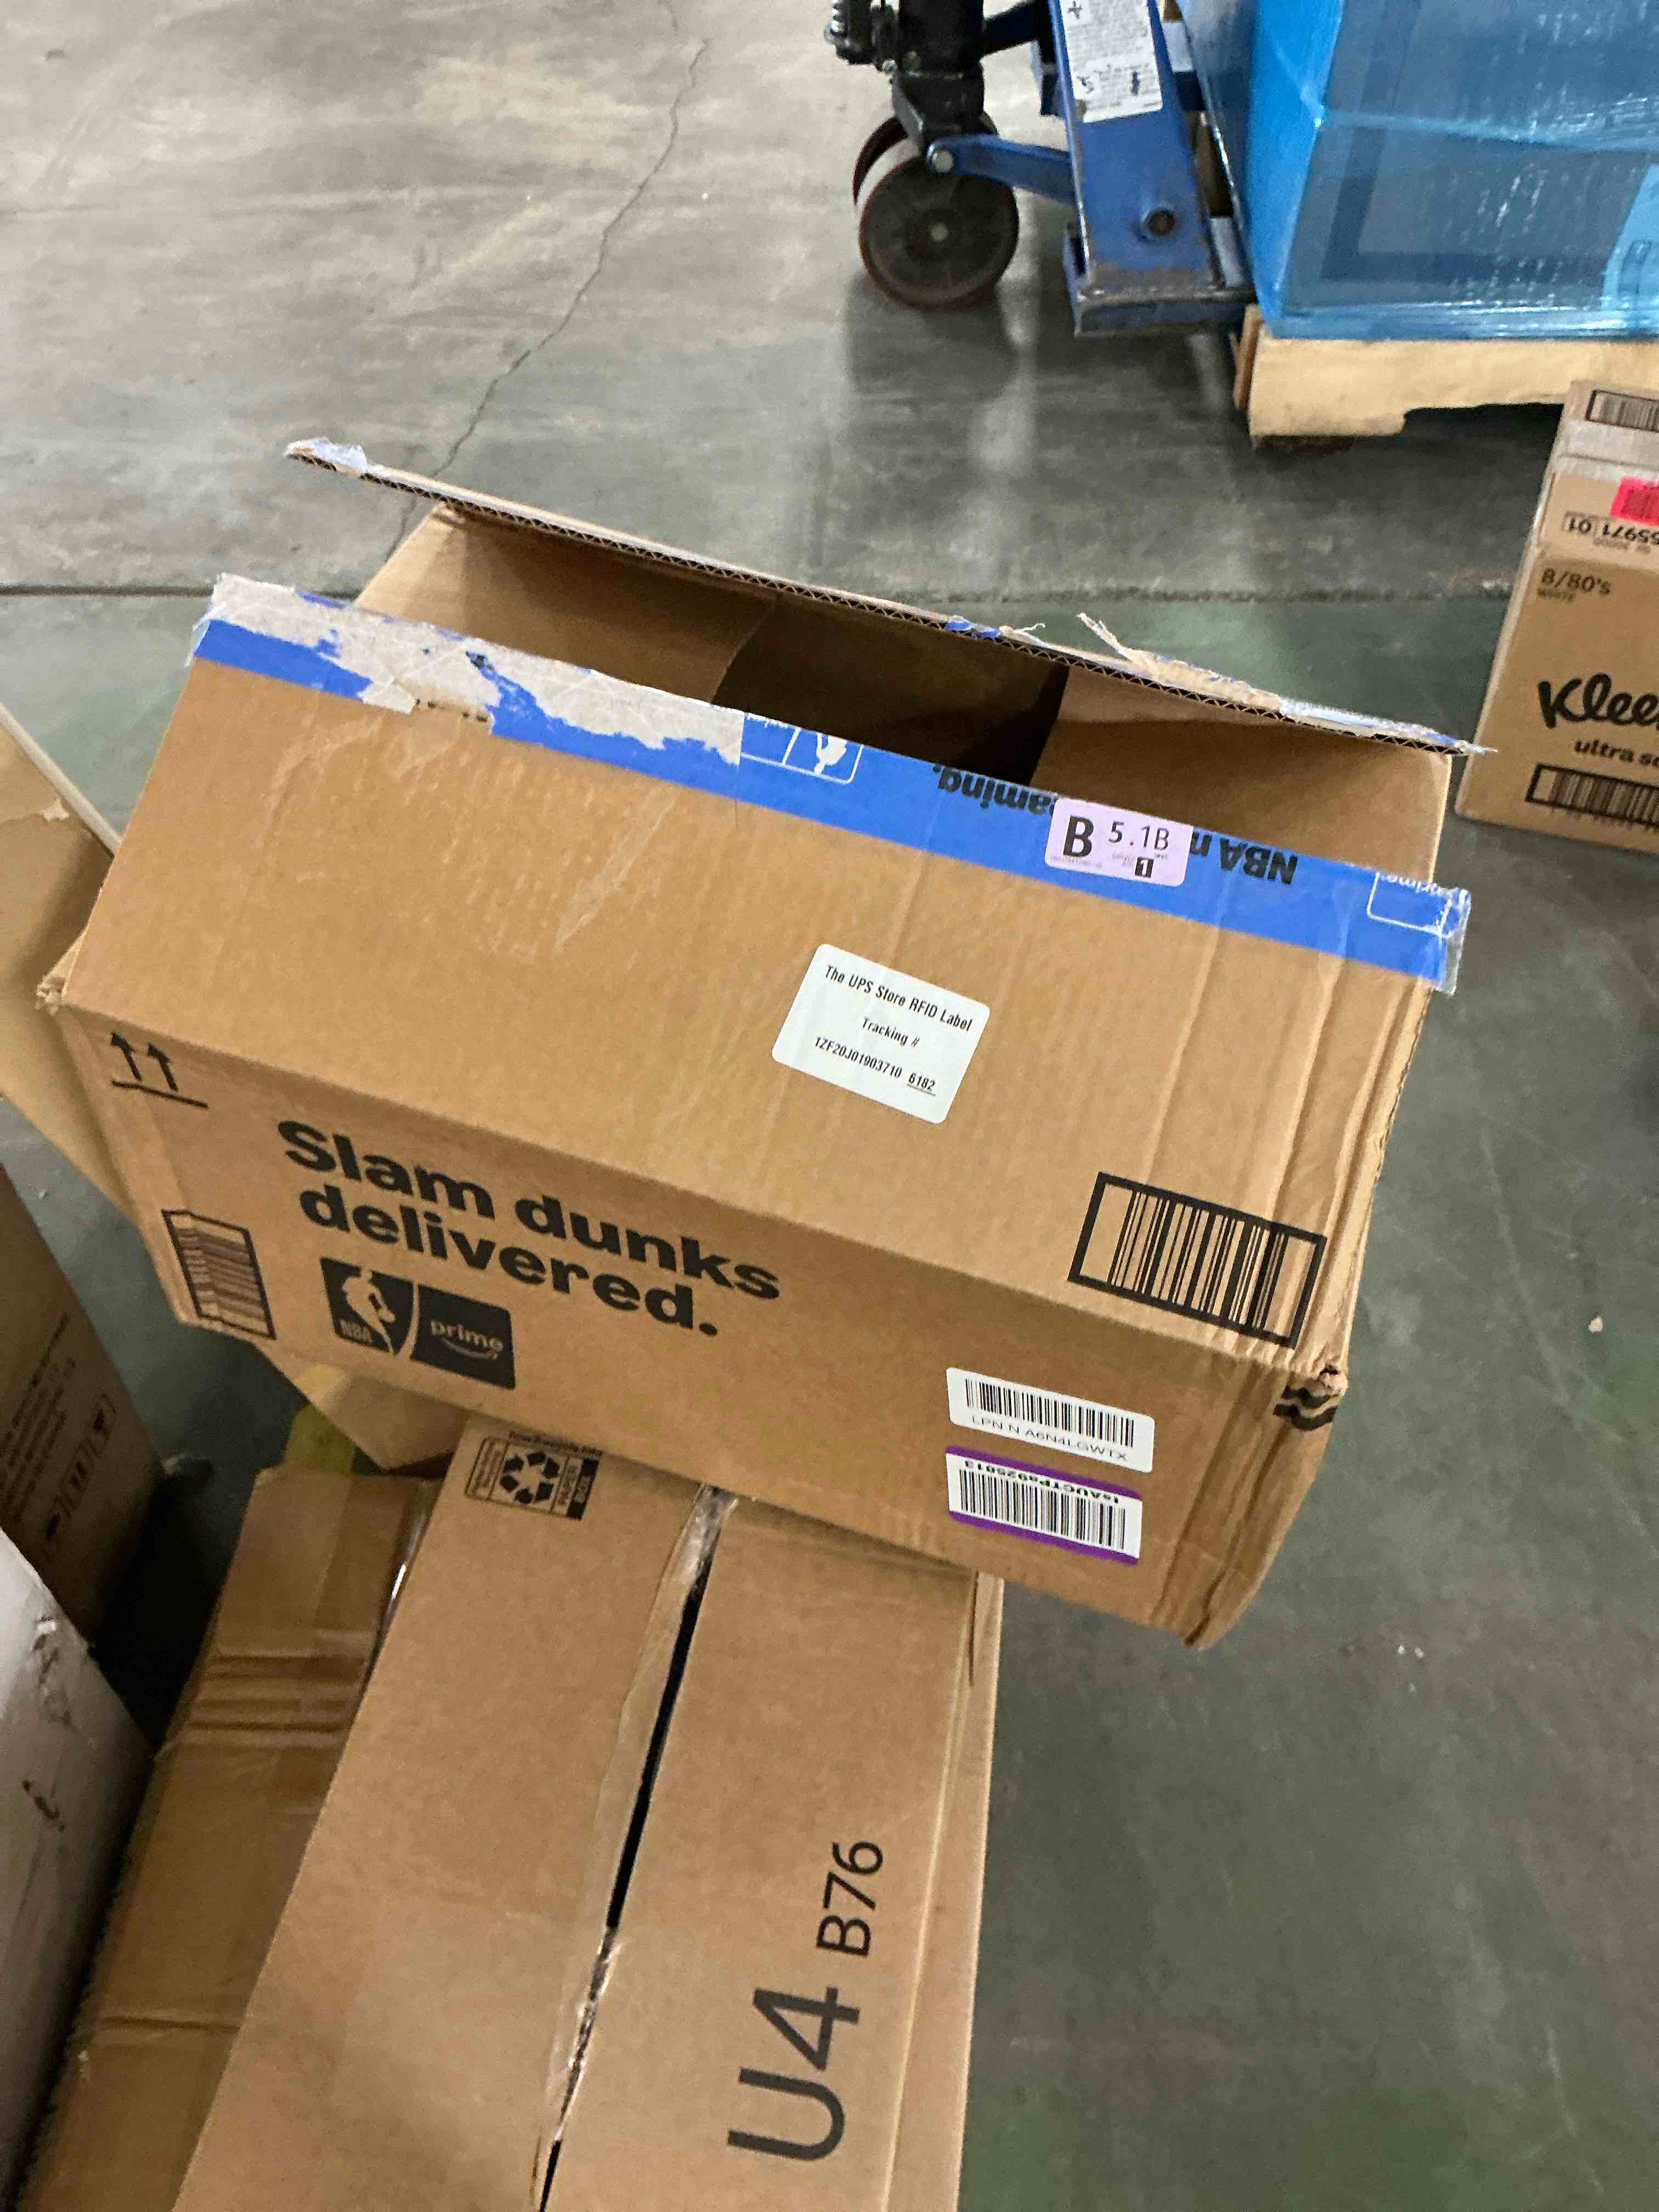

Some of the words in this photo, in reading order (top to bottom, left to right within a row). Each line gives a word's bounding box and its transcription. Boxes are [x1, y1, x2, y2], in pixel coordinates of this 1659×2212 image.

[1541, 567, 1611, 596] 8/80's
[1537, 672, 1659, 729] Klee
[1575, 738, 1634, 763] ultra
[932, 763, 1054, 817] aming.
[1063, 815, 1094, 858] B
[1108, 821, 1170, 851] 5.1B
[1219, 837, 1299, 885] NBA
[825, 964, 845, 983] The
[849, 973, 873, 994] UPS
[876, 985, 906, 1007] Store
[909, 997, 938, 1019] RFID
[940, 1008, 973, 1032] Label
[862, 1016, 909, 1047] Tracking
[910, 1036, 920, 1048] #
[815, 1036, 902, 1079] 1ZF20J01903710
[908, 1072, 936, 1092] 6182
[277, 1119, 496, 1221] Slam
[514, 1194, 781, 1300] dunks
[298, 1183, 719, 1337] delivered.
[337, 1318, 373, 1347] NBA
[430, 1319, 504, 1352] prime
[726, 1986, 862, 2162] U4
[815, 1841, 884, 1958] B76
